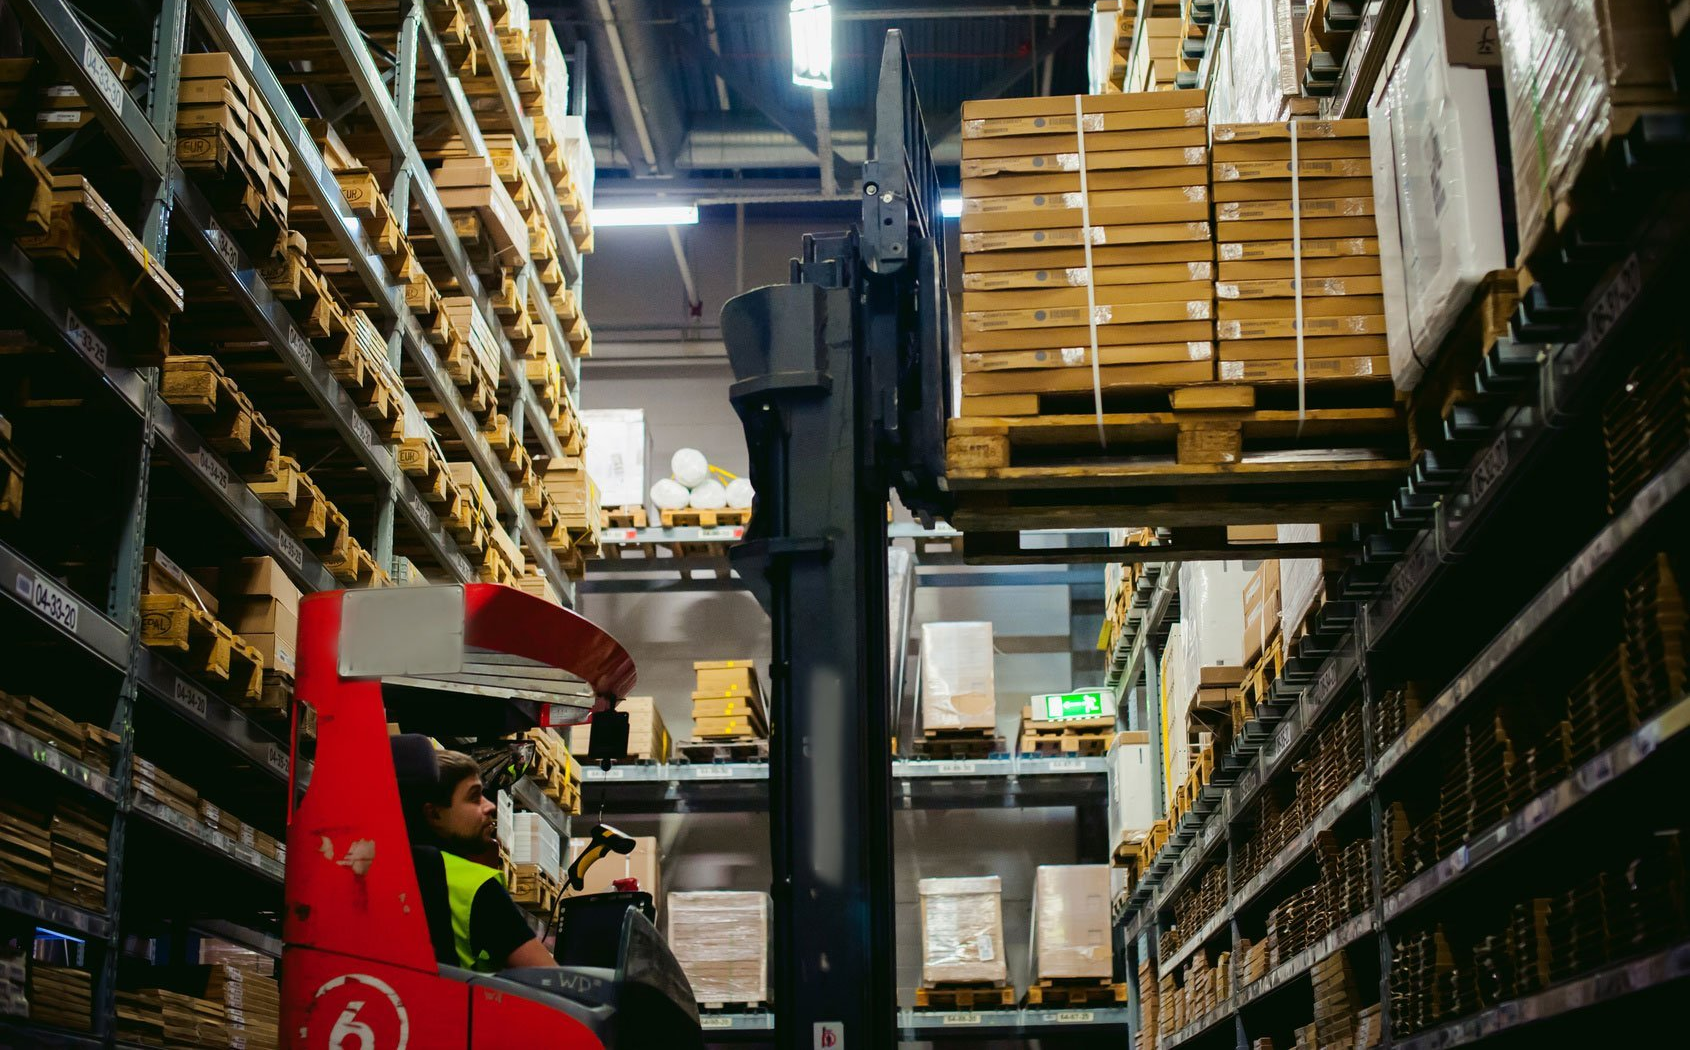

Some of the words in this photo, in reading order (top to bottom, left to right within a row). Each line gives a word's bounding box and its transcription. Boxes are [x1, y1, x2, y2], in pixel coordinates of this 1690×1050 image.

[87, 48, 121, 110] 04-33-30
[184, 141, 203, 153] EUR
[69, 315, 105, 364] 04-33-25
[200, 451, 228, 490] 04-34-25
[279, 533, 303, 564] 04-35-25
[35, 582, 76, 627] 04-33-20
[176, 683, 206, 714] 04-34-20
[269, 748, 290, 773] 04-35-2
[329, 1001, 376, 1050] 6
